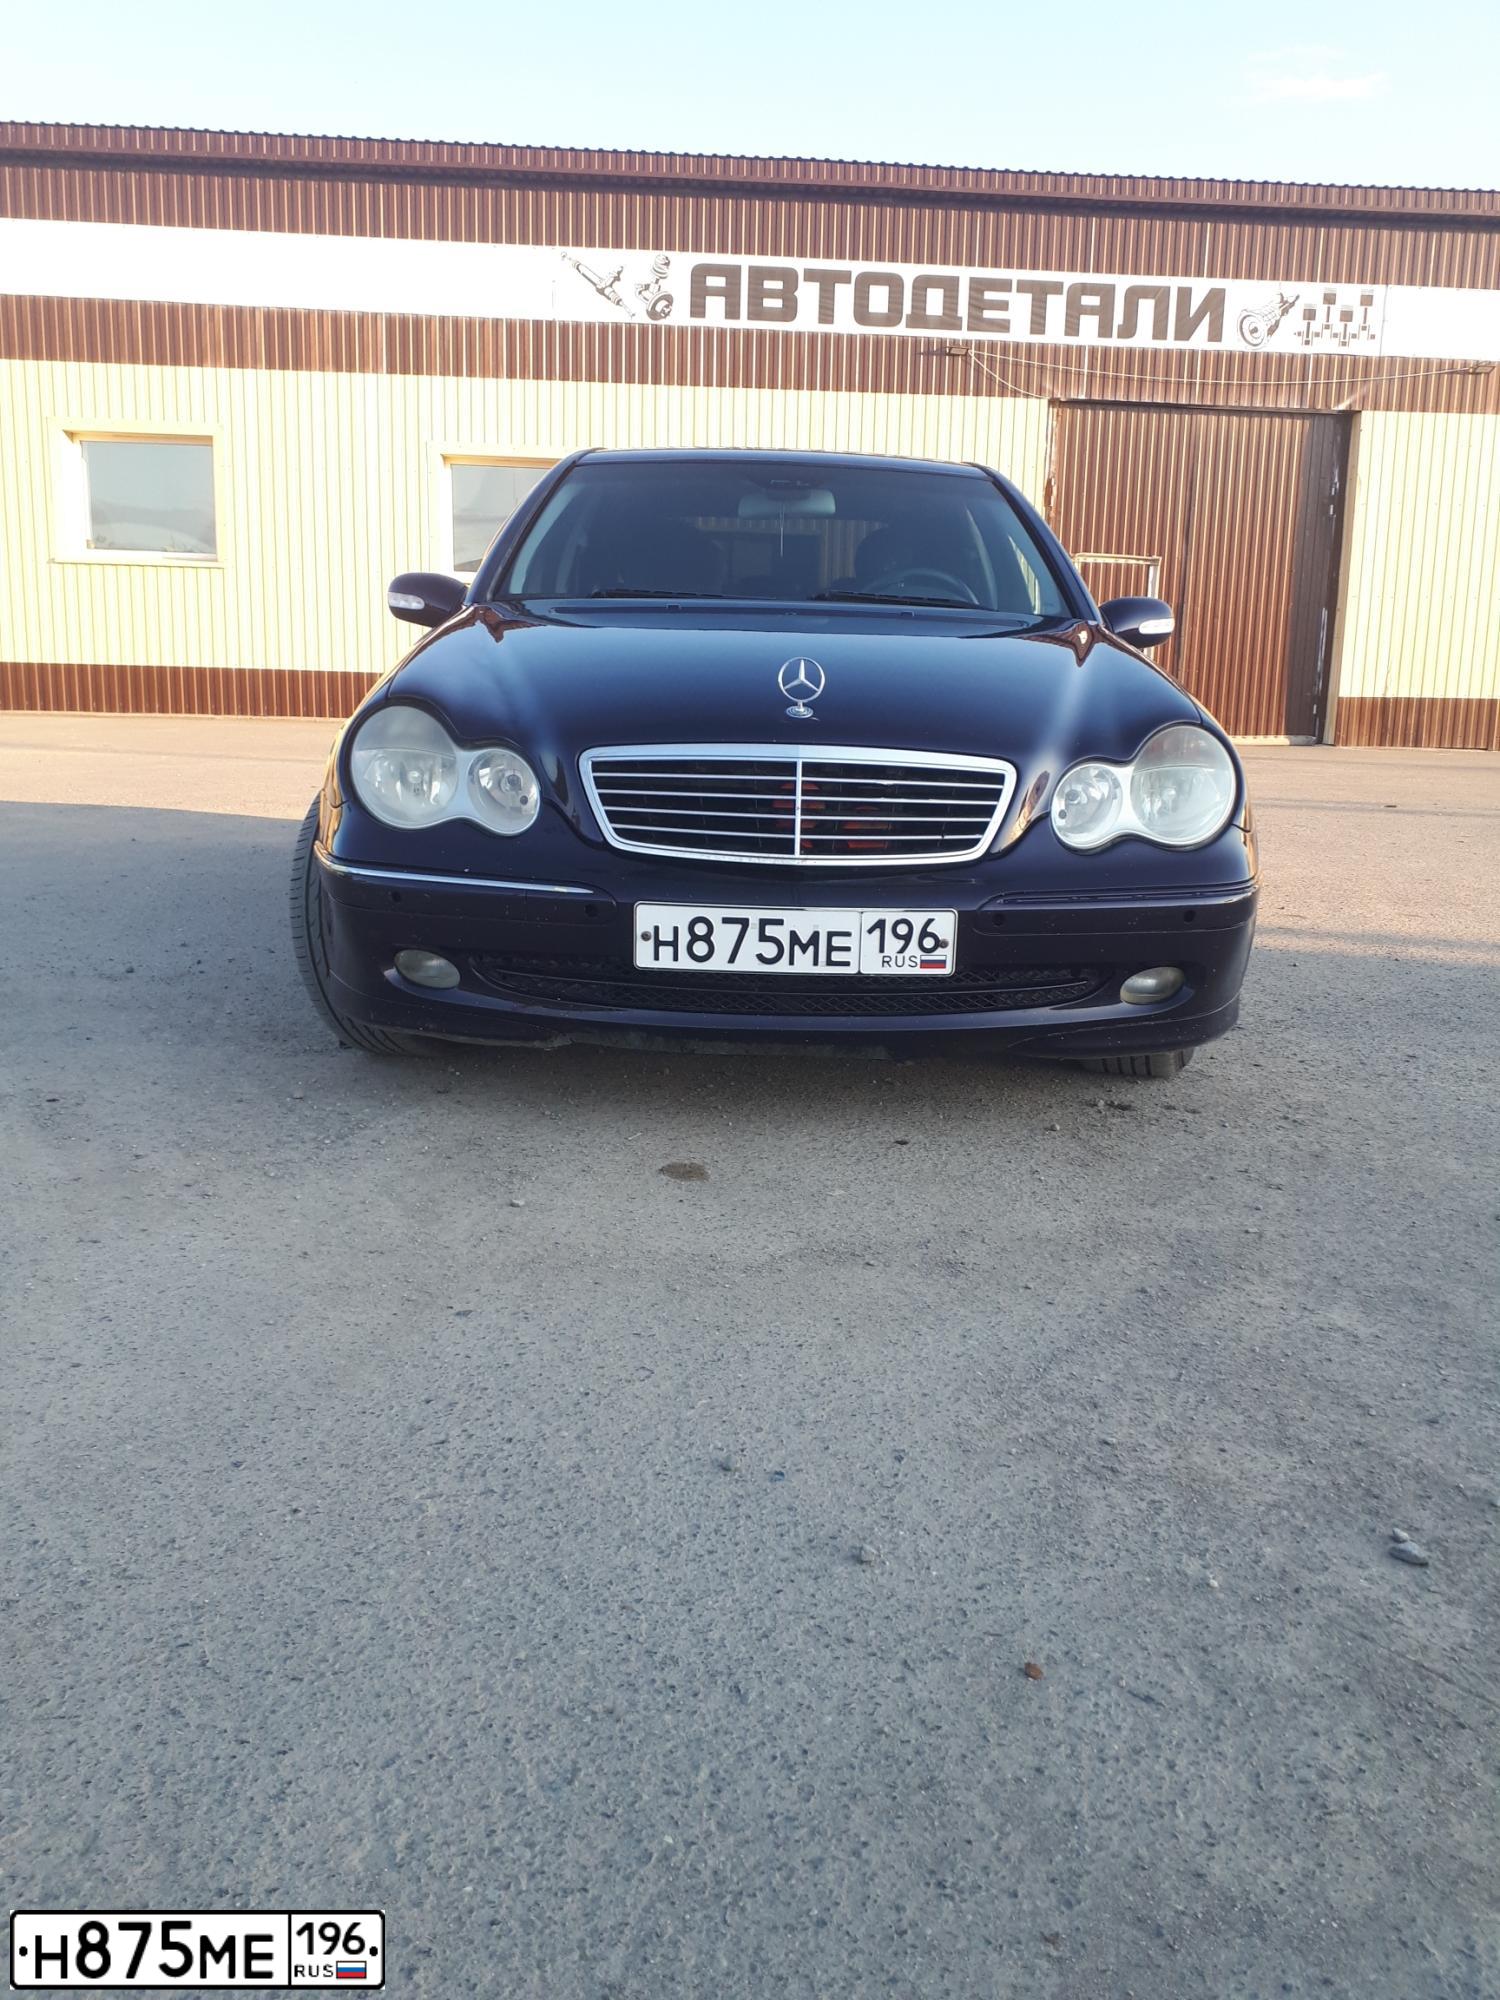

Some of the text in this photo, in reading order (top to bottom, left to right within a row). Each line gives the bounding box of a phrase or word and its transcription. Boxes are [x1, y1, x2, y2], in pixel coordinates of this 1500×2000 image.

[690, 263, 1226, 342] АВТОДЕТАЛИ
[866, 917, 941, 954] 196
[881, 955, 918, 968] RUS
